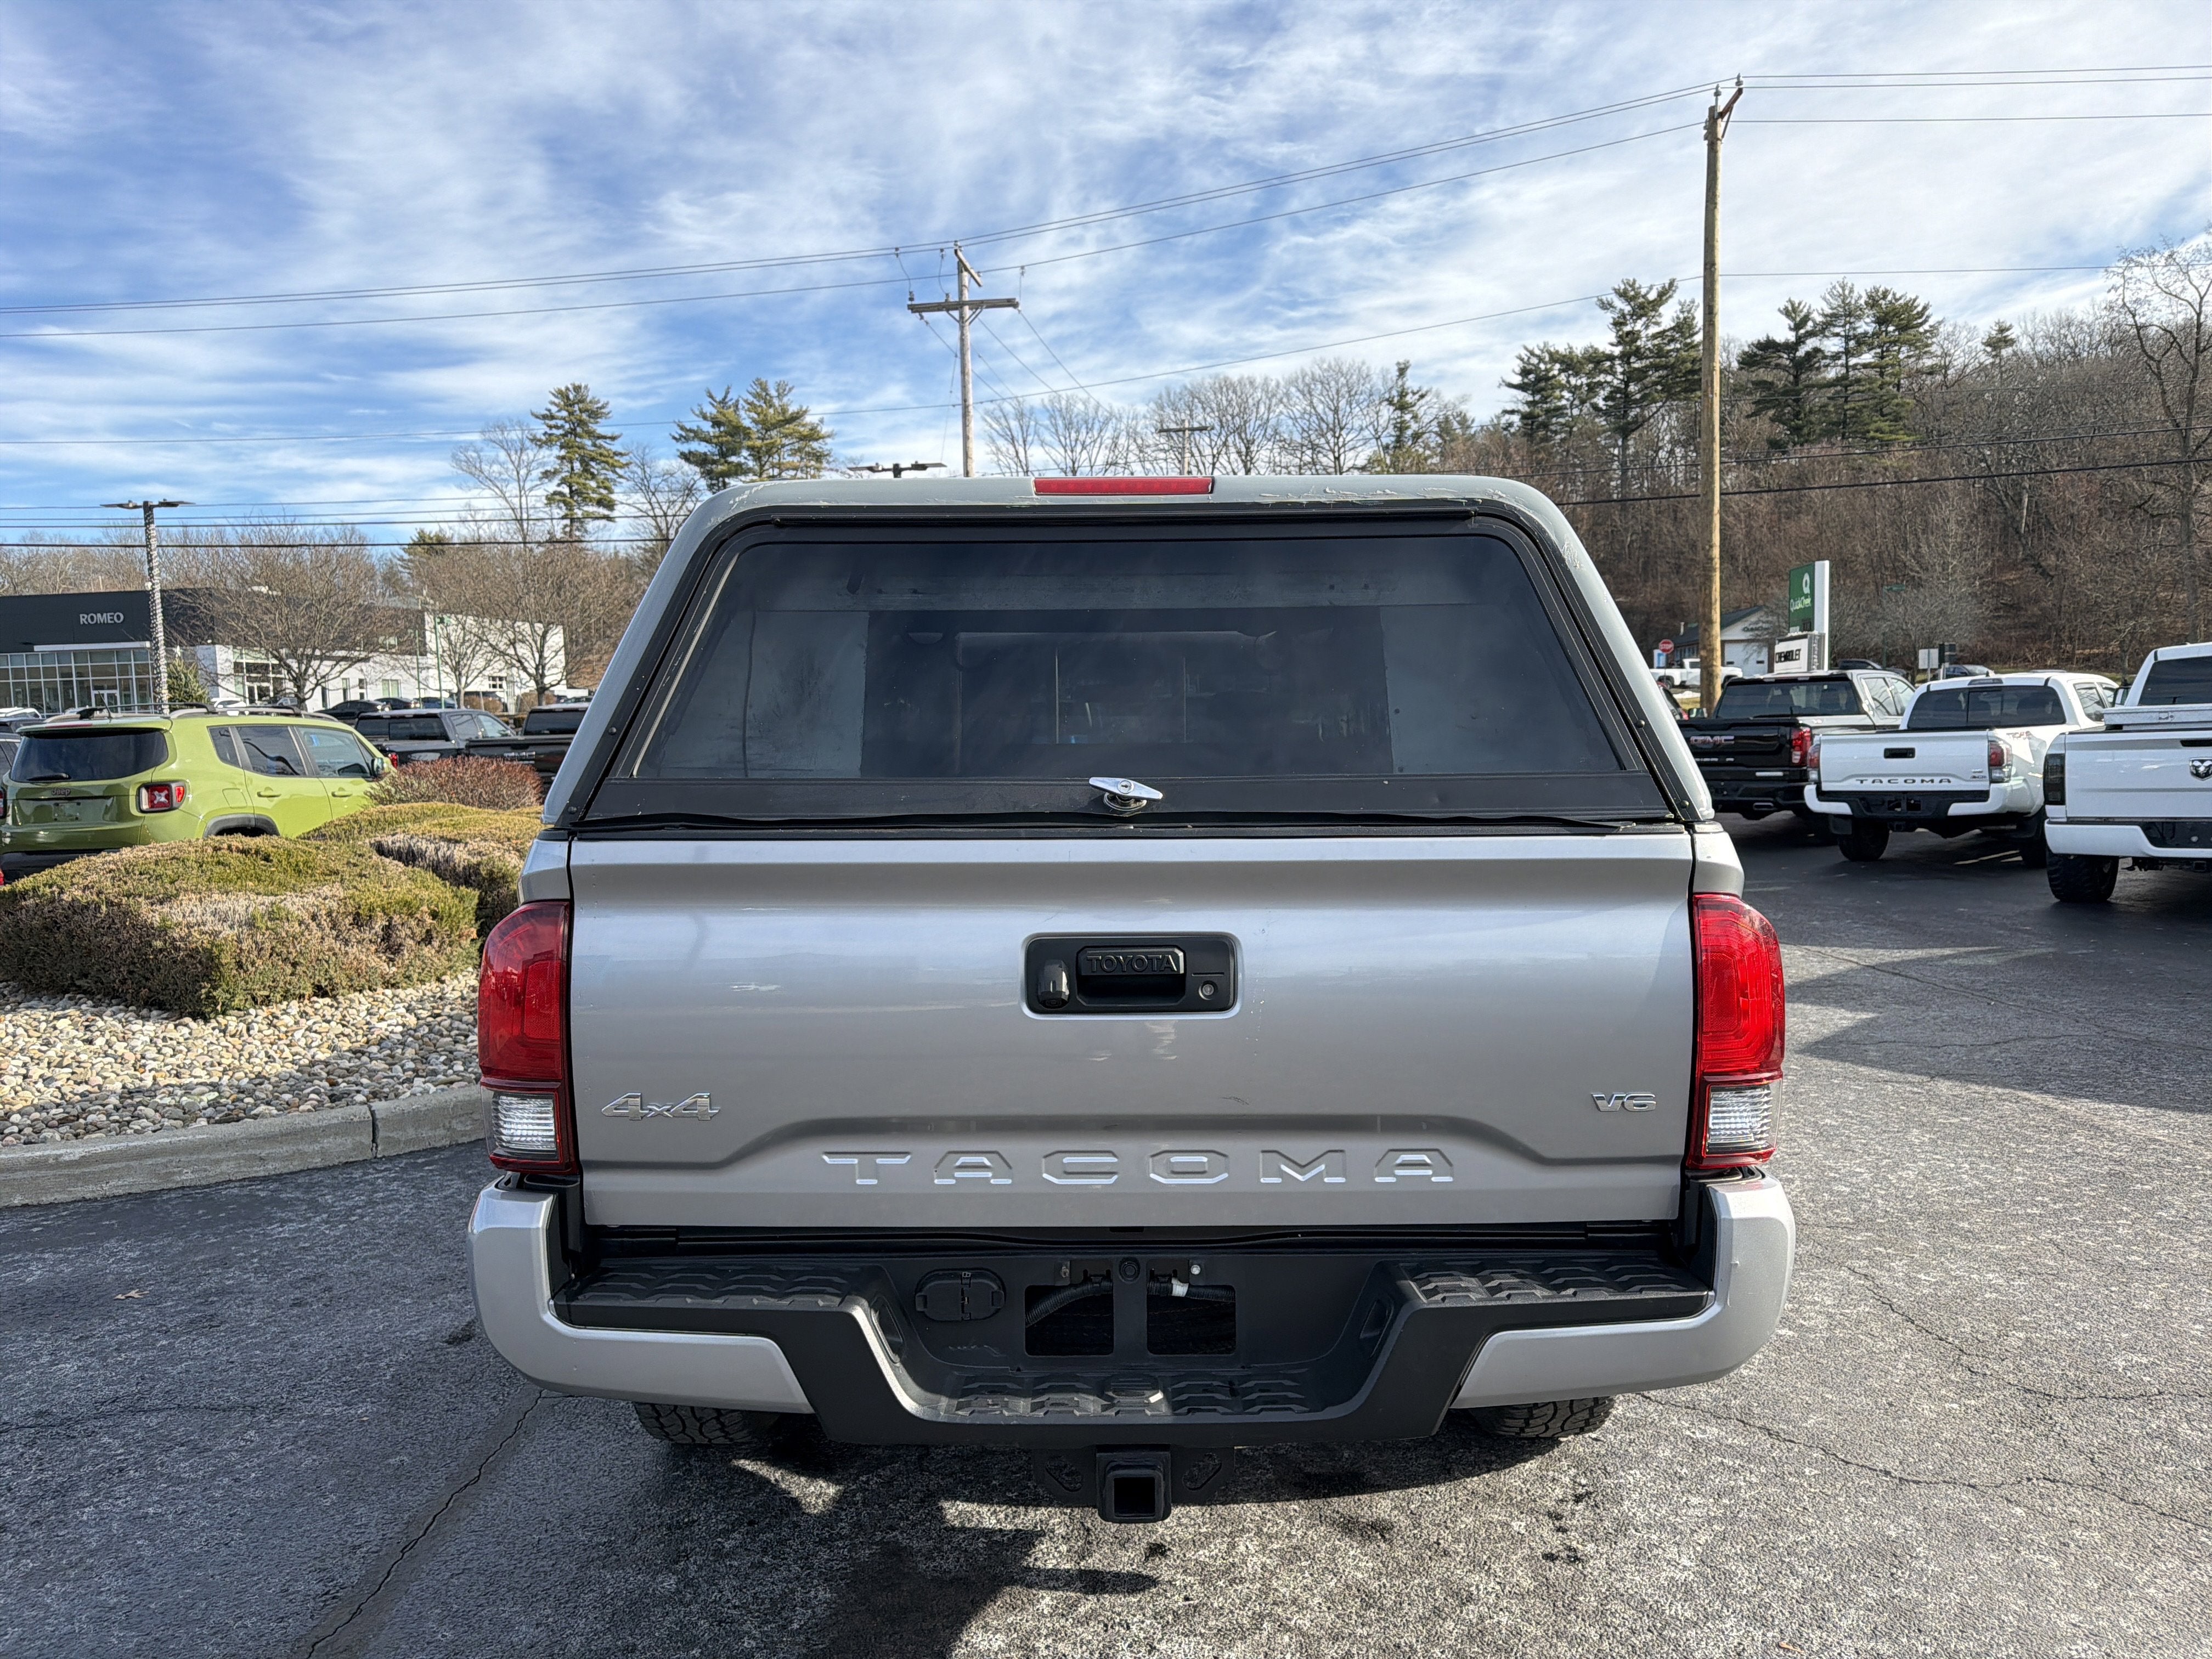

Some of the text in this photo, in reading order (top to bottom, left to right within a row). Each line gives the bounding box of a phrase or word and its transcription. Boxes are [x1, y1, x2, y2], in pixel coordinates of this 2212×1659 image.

[80, 612, 124, 624] ROMEO
[1690, 736, 1735, 744] GMC
[52, 788, 70, 797] Jeep
[1087, 954, 1178, 973] TOYOTA
[601, 1092, 720, 1121] 4x4
[1591, 1092, 1656, 1112] V6
[822, 1149, 1454, 1184] TACOMA
